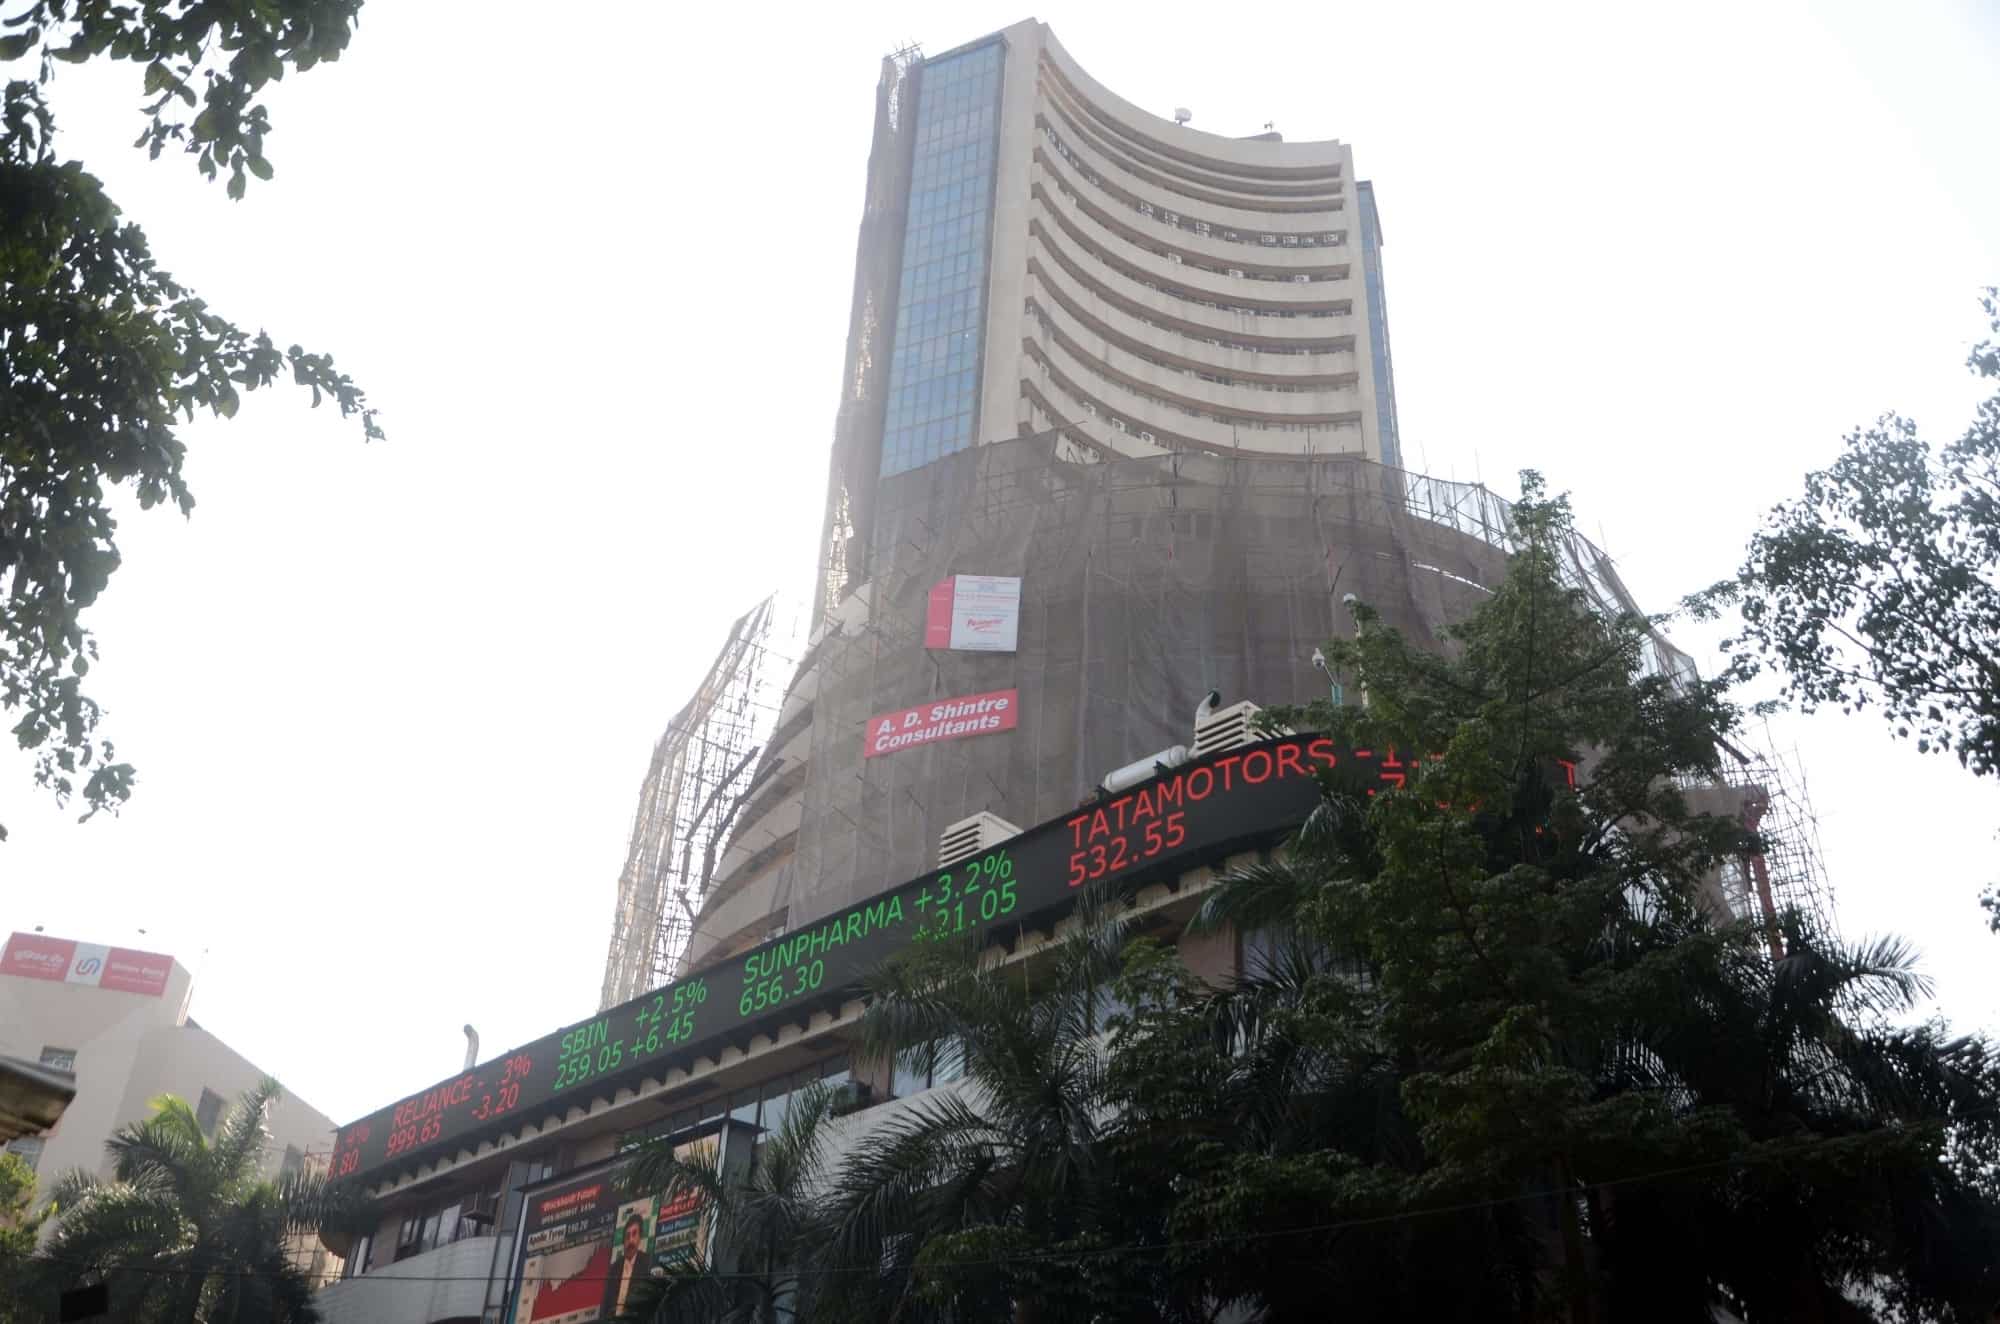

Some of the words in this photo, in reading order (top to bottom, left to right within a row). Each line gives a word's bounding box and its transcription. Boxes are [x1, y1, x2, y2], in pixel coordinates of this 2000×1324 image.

[875, 715, 1000, 751] Consultants
[877, 719, 896, 736] A.
[904, 712, 922, 728] D.
[930, 698, 1009, 722] Shintre
[1067, 739, 1337, 848] TATAMOTORS
[1068, 812, 1185, 888] 532.55
[739, 960, 824, 1016] 656.30
[912, 880, 1017, 944] +21.05
[743, 896, 905, 985] SUNPHARMA
[914, 850, 1012, 912] +3.2%
[553, 1040, 624, 1090] 259.05
[630, 1011, 696, 1060] +6.45
[560, 1018, 609, 1060] SBIN
[635, 978, 708, 1029] +2.5%
[384, 1116, 443, 1158] 999.65
[471, 1082, 520, 1121] -3.20
[392, 1074, 472, 1128] RELIANCE
